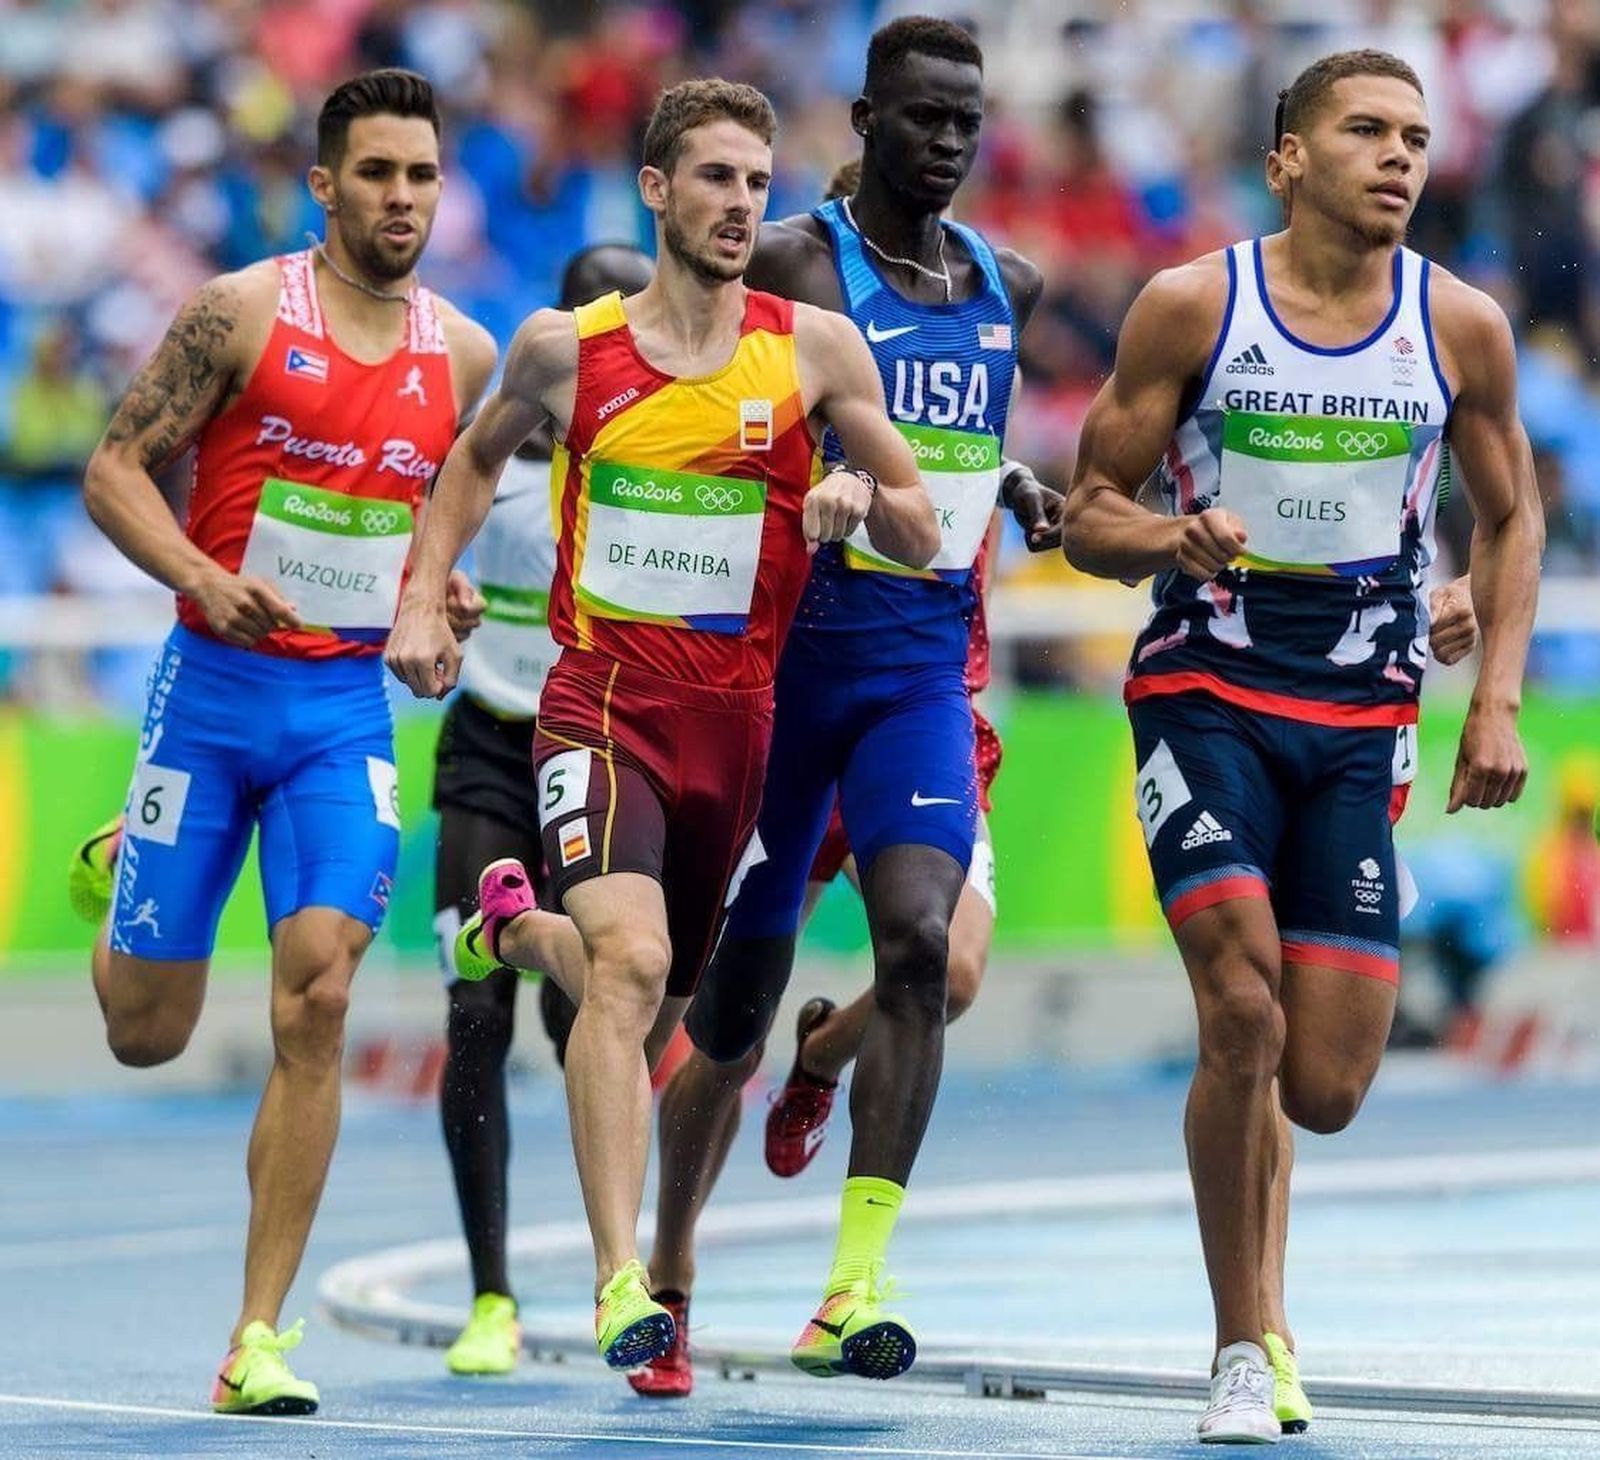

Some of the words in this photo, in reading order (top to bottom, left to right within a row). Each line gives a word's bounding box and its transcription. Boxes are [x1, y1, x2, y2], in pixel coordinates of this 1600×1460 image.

[1225, 363, 1275, 376] adidas
[893, 359, 989, 428] USA
[1225, 389, 1313, 415] GREAT
[1322, 395, 1429, 422] BRITAIN
[256, 415, 366, 467] Puerto
[910, 438, 945, 461] 2016
[1249, 427, 1325, 451] Rio2016
[612, 477, 683, 503] Rio2016
[283, 495, 353, 526] Rio2016
[1277, 498, 1347, 522] GILES
[277, 556, 378, 594] VAZQUEZ
[608, 543, 637, 566] DE
[642, 548, 731, 578] ARRIBA
[140, 785, 164, 825] 6
[544, 769, 567, 811] 5
[1141, 776, 1163, 823] 3
[1181, 829, 1233, 850] adidas
